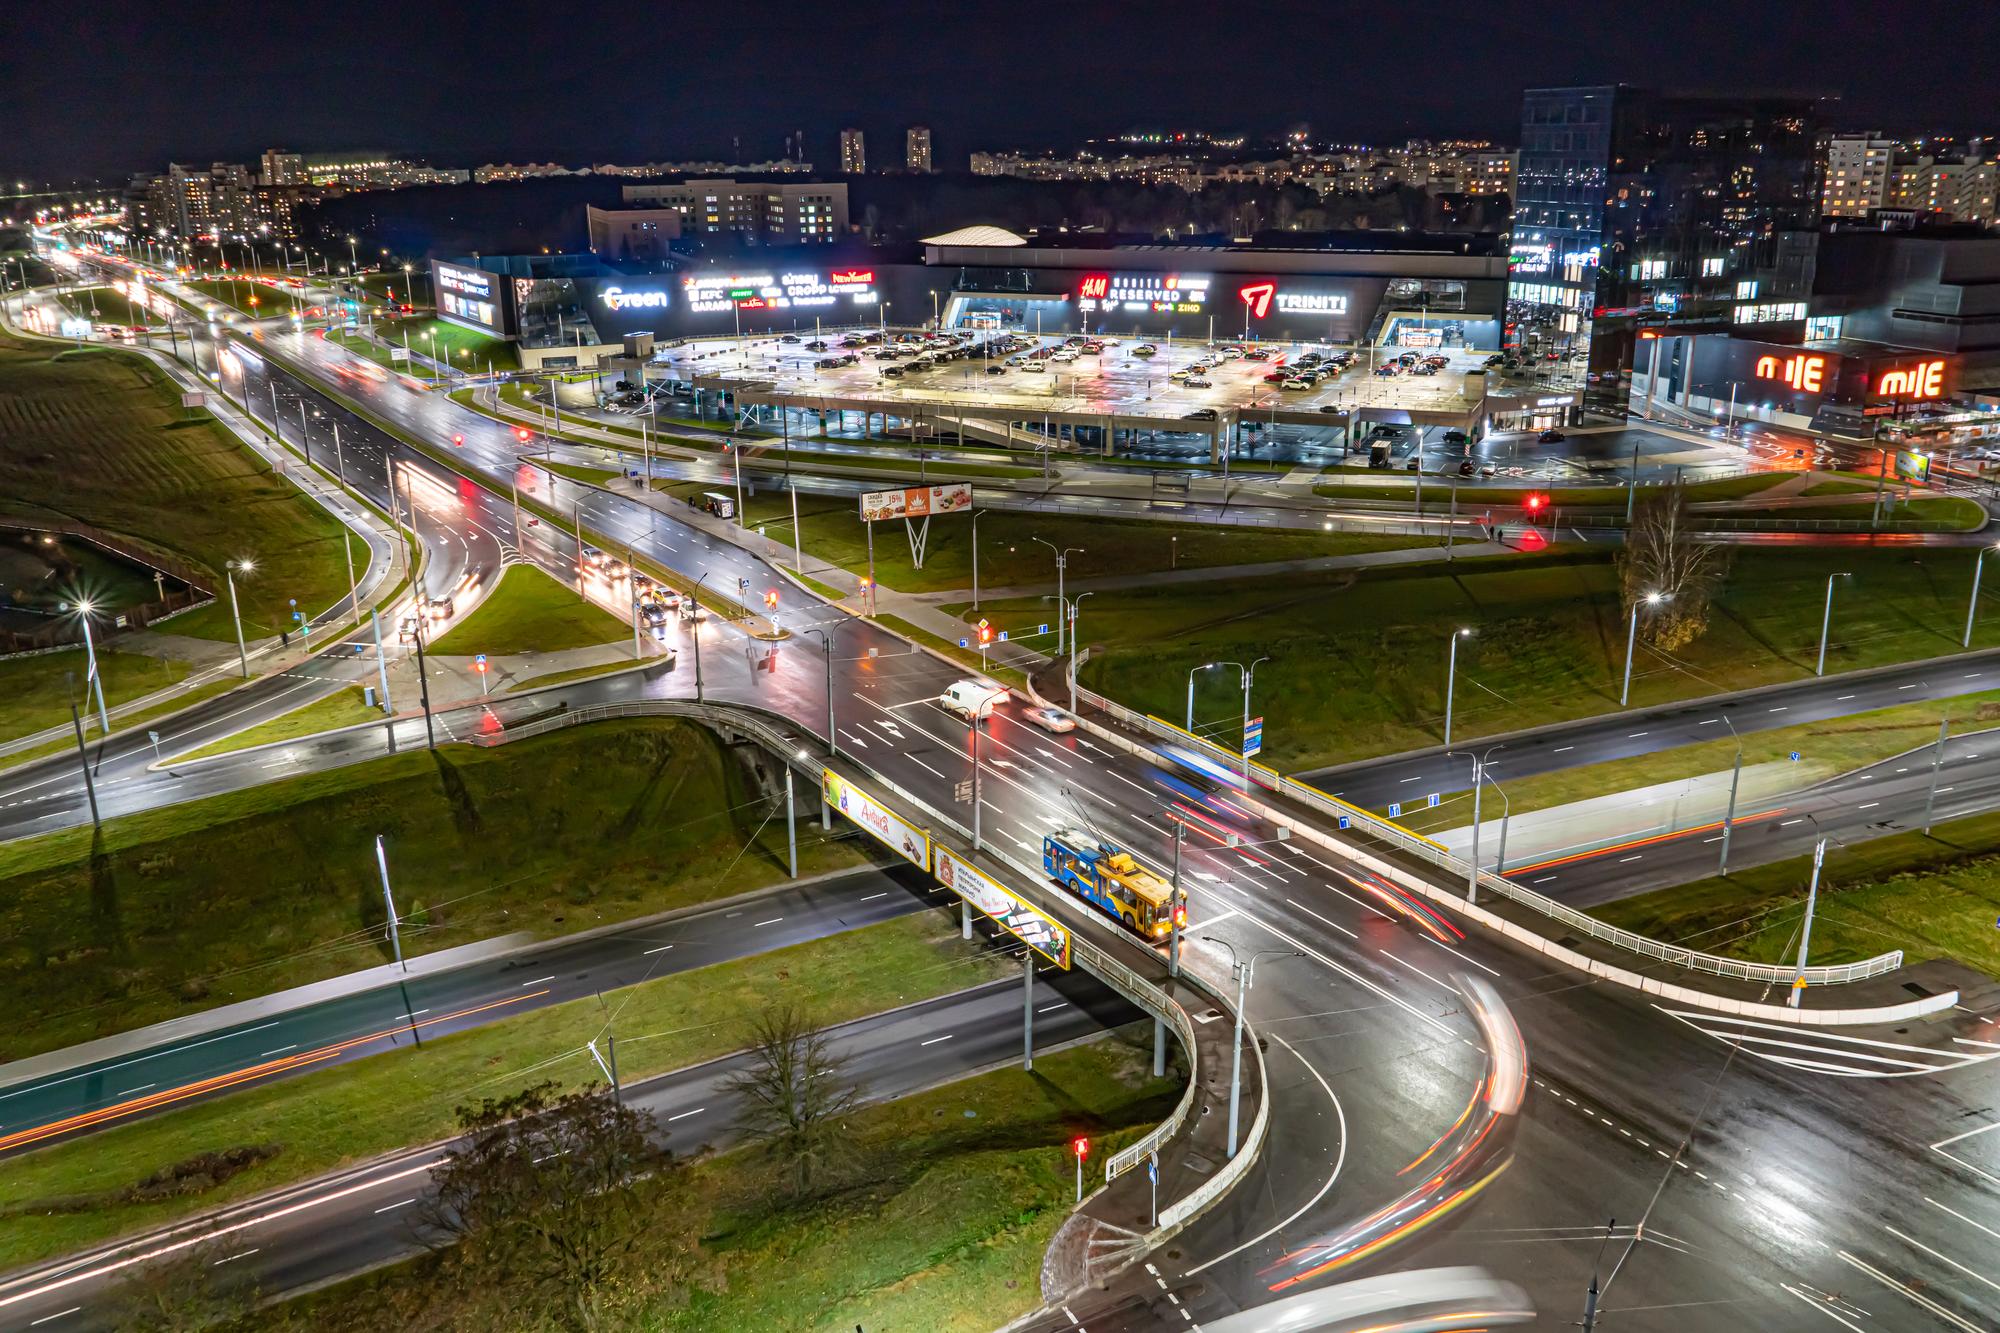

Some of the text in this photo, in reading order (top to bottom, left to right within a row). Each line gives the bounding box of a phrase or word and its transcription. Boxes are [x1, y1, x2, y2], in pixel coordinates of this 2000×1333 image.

[602, 287, 667, 308] Green
[1110, 289, 1180, 301] RESERVED
[1178, 304, 1201, 312] ZIKO
[1276, 295, 1347, 309] TRINITI
